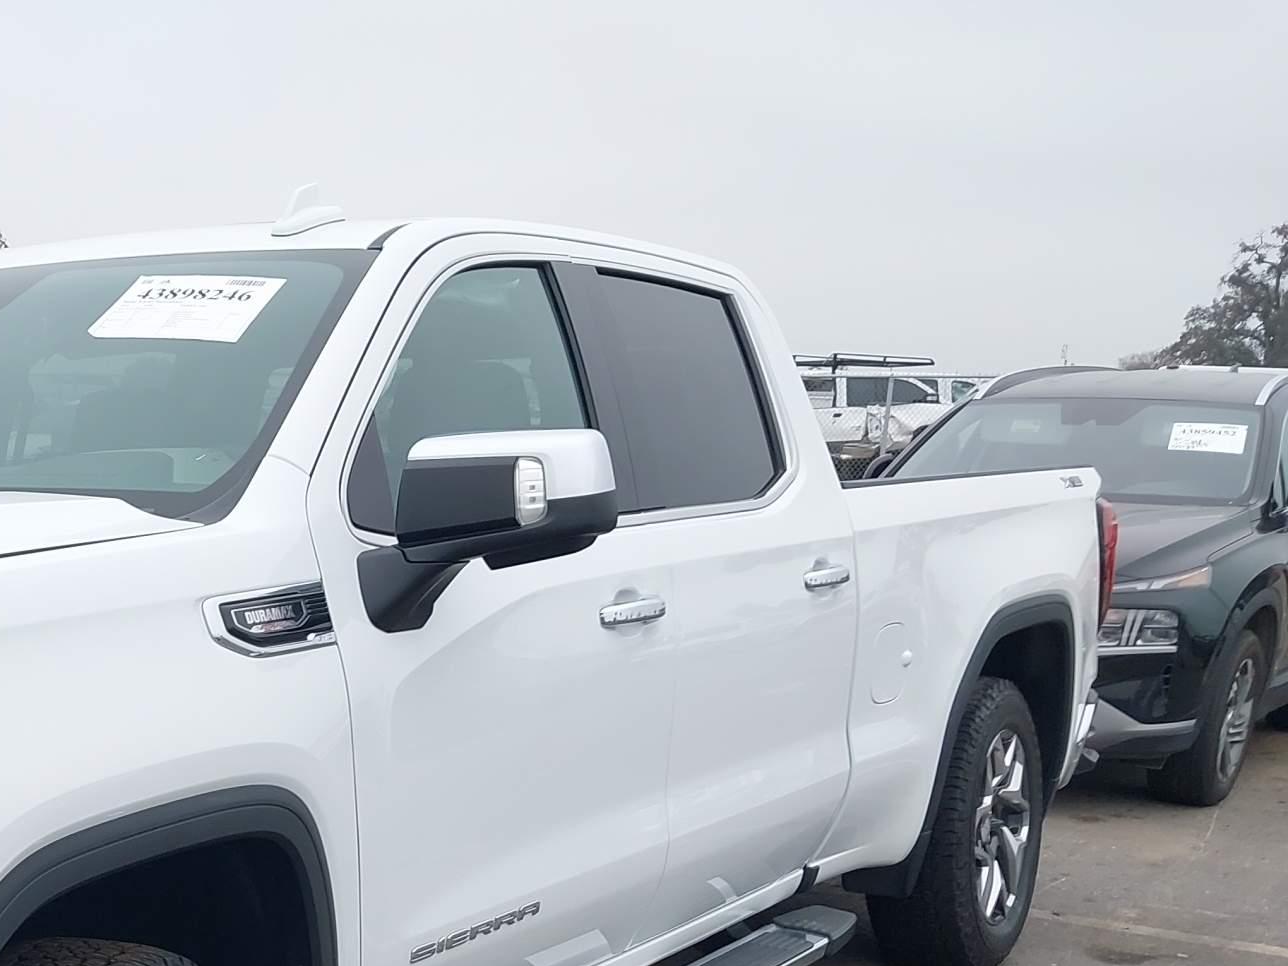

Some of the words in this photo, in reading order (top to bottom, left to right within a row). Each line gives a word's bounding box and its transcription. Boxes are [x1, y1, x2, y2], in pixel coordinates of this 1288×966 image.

[136, 287, 257, 302] 43898246
[244, 604, 297, 625] DURAMAX
[409, 899, 541, 964] SIERRA
